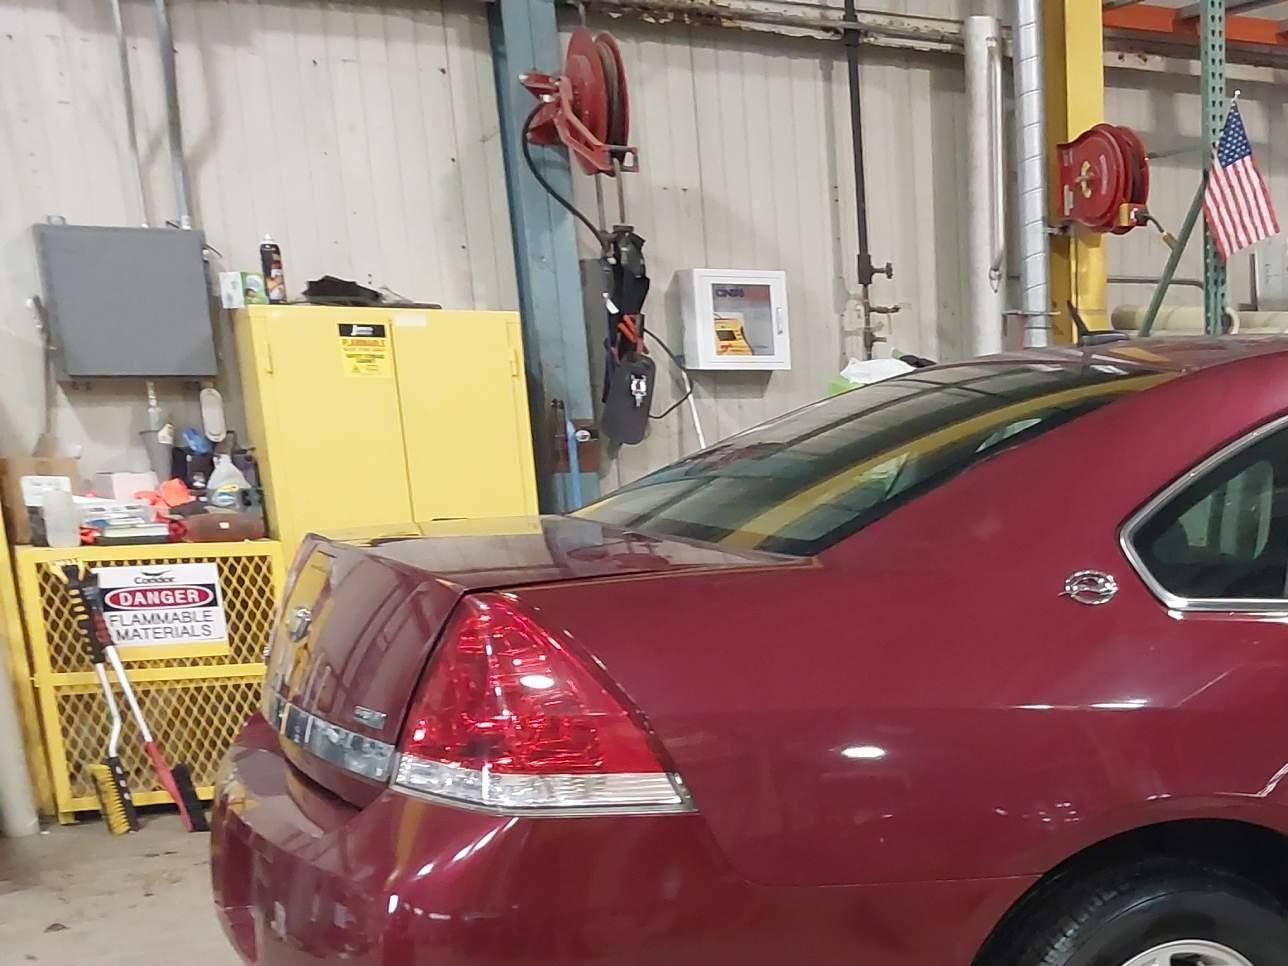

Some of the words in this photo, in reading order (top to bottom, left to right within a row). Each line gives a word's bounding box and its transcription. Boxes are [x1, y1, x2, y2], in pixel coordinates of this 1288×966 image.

[119, 589, 201, 606] DANGER
[109, 610, 214, 627] FLAMMABLE
[115, 624, 212, 641] MATERIALS
